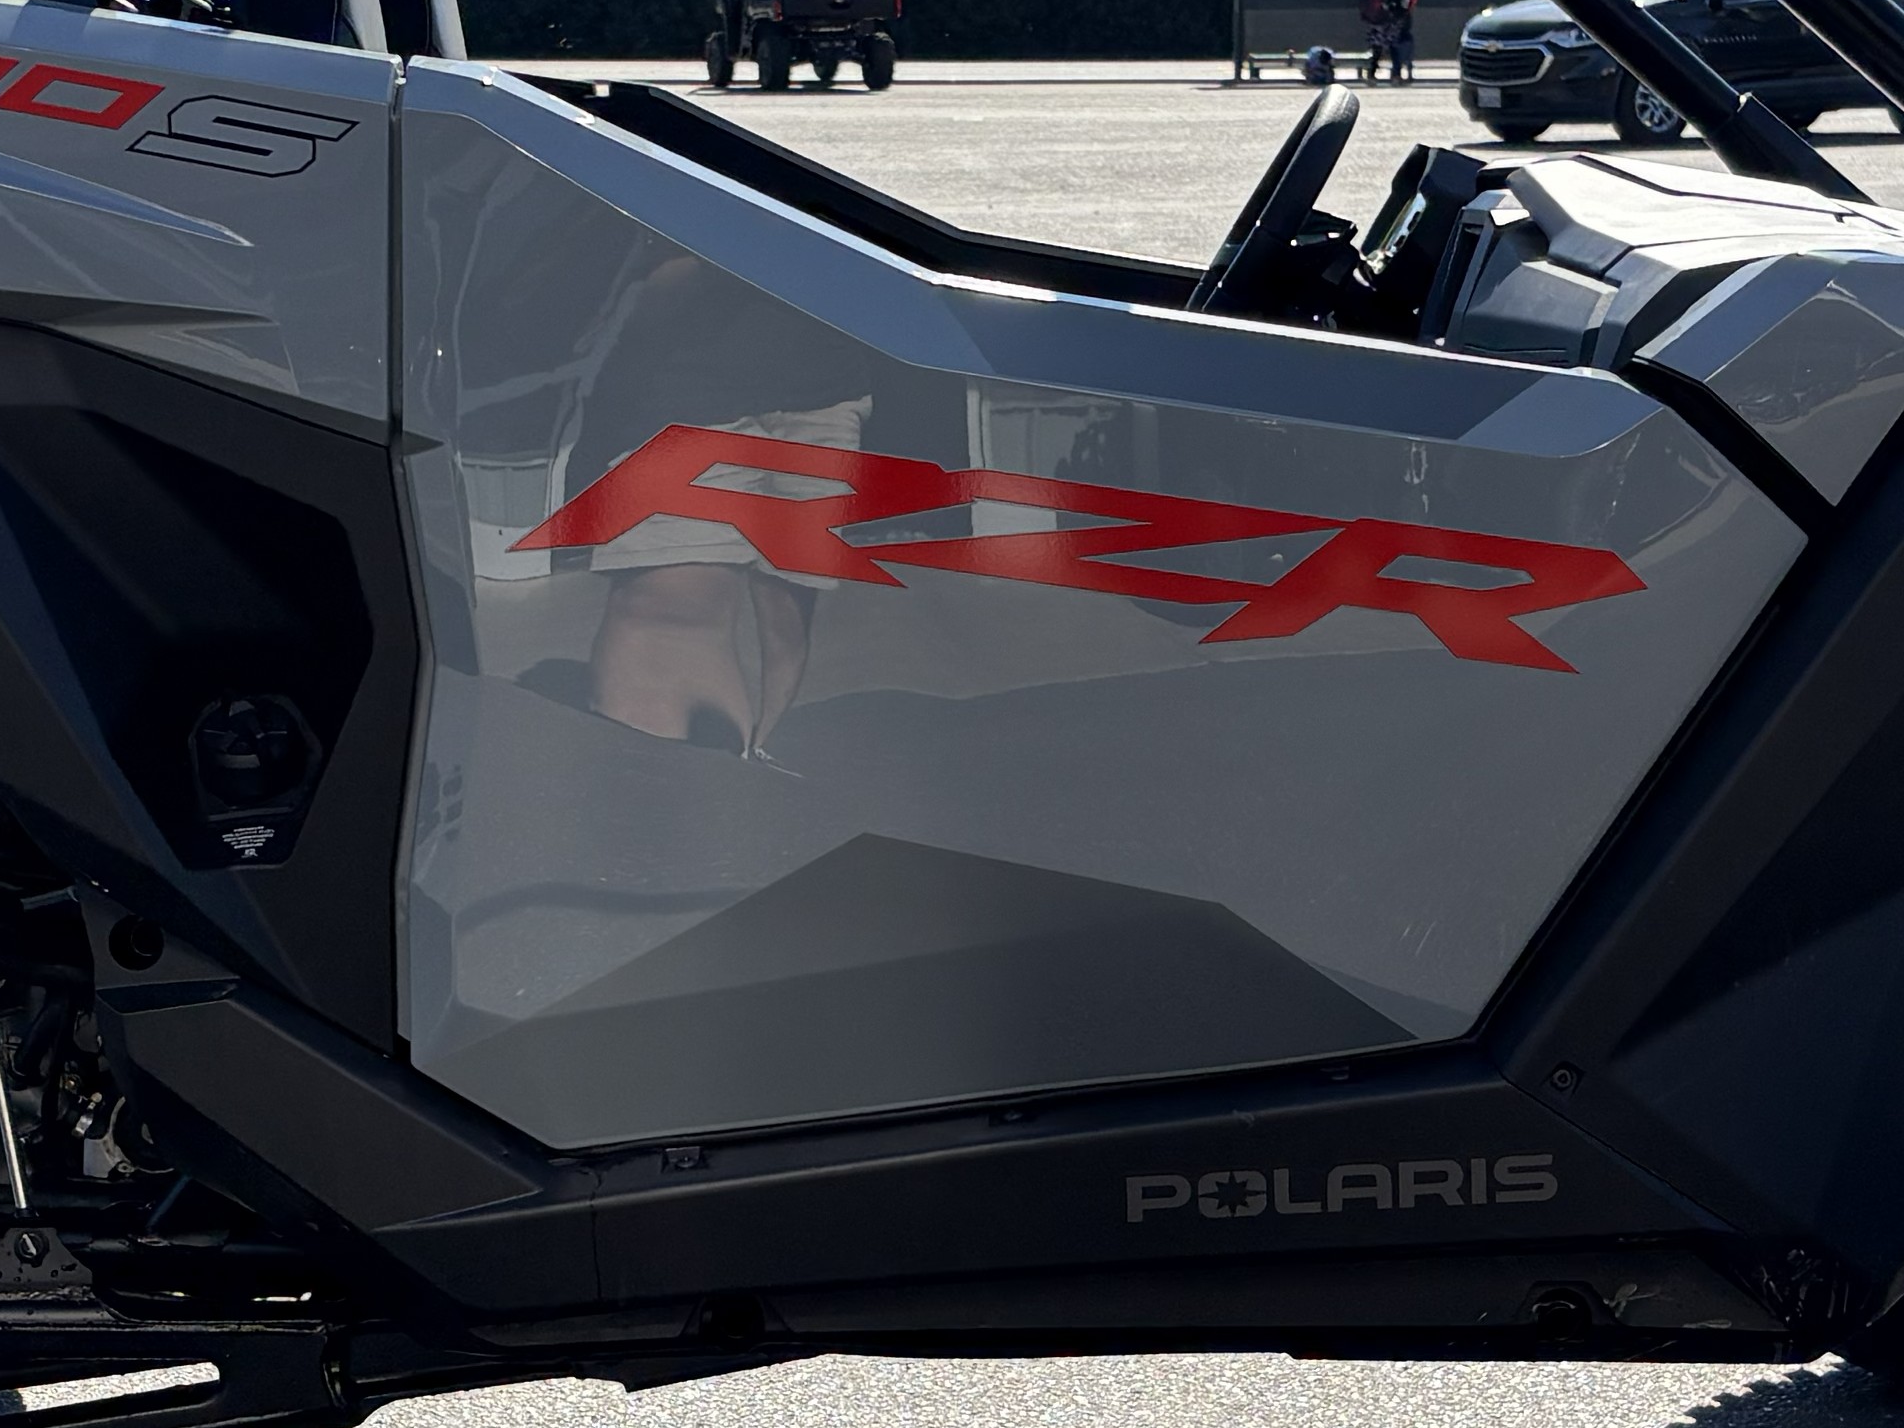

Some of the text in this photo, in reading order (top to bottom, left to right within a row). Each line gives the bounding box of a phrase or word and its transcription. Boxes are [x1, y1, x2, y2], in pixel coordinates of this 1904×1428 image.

[125, 94, 360, 178] S
[504, 423, 1649, 674] RZR
[1125, 1153, 1559, 1223] POLARIS
